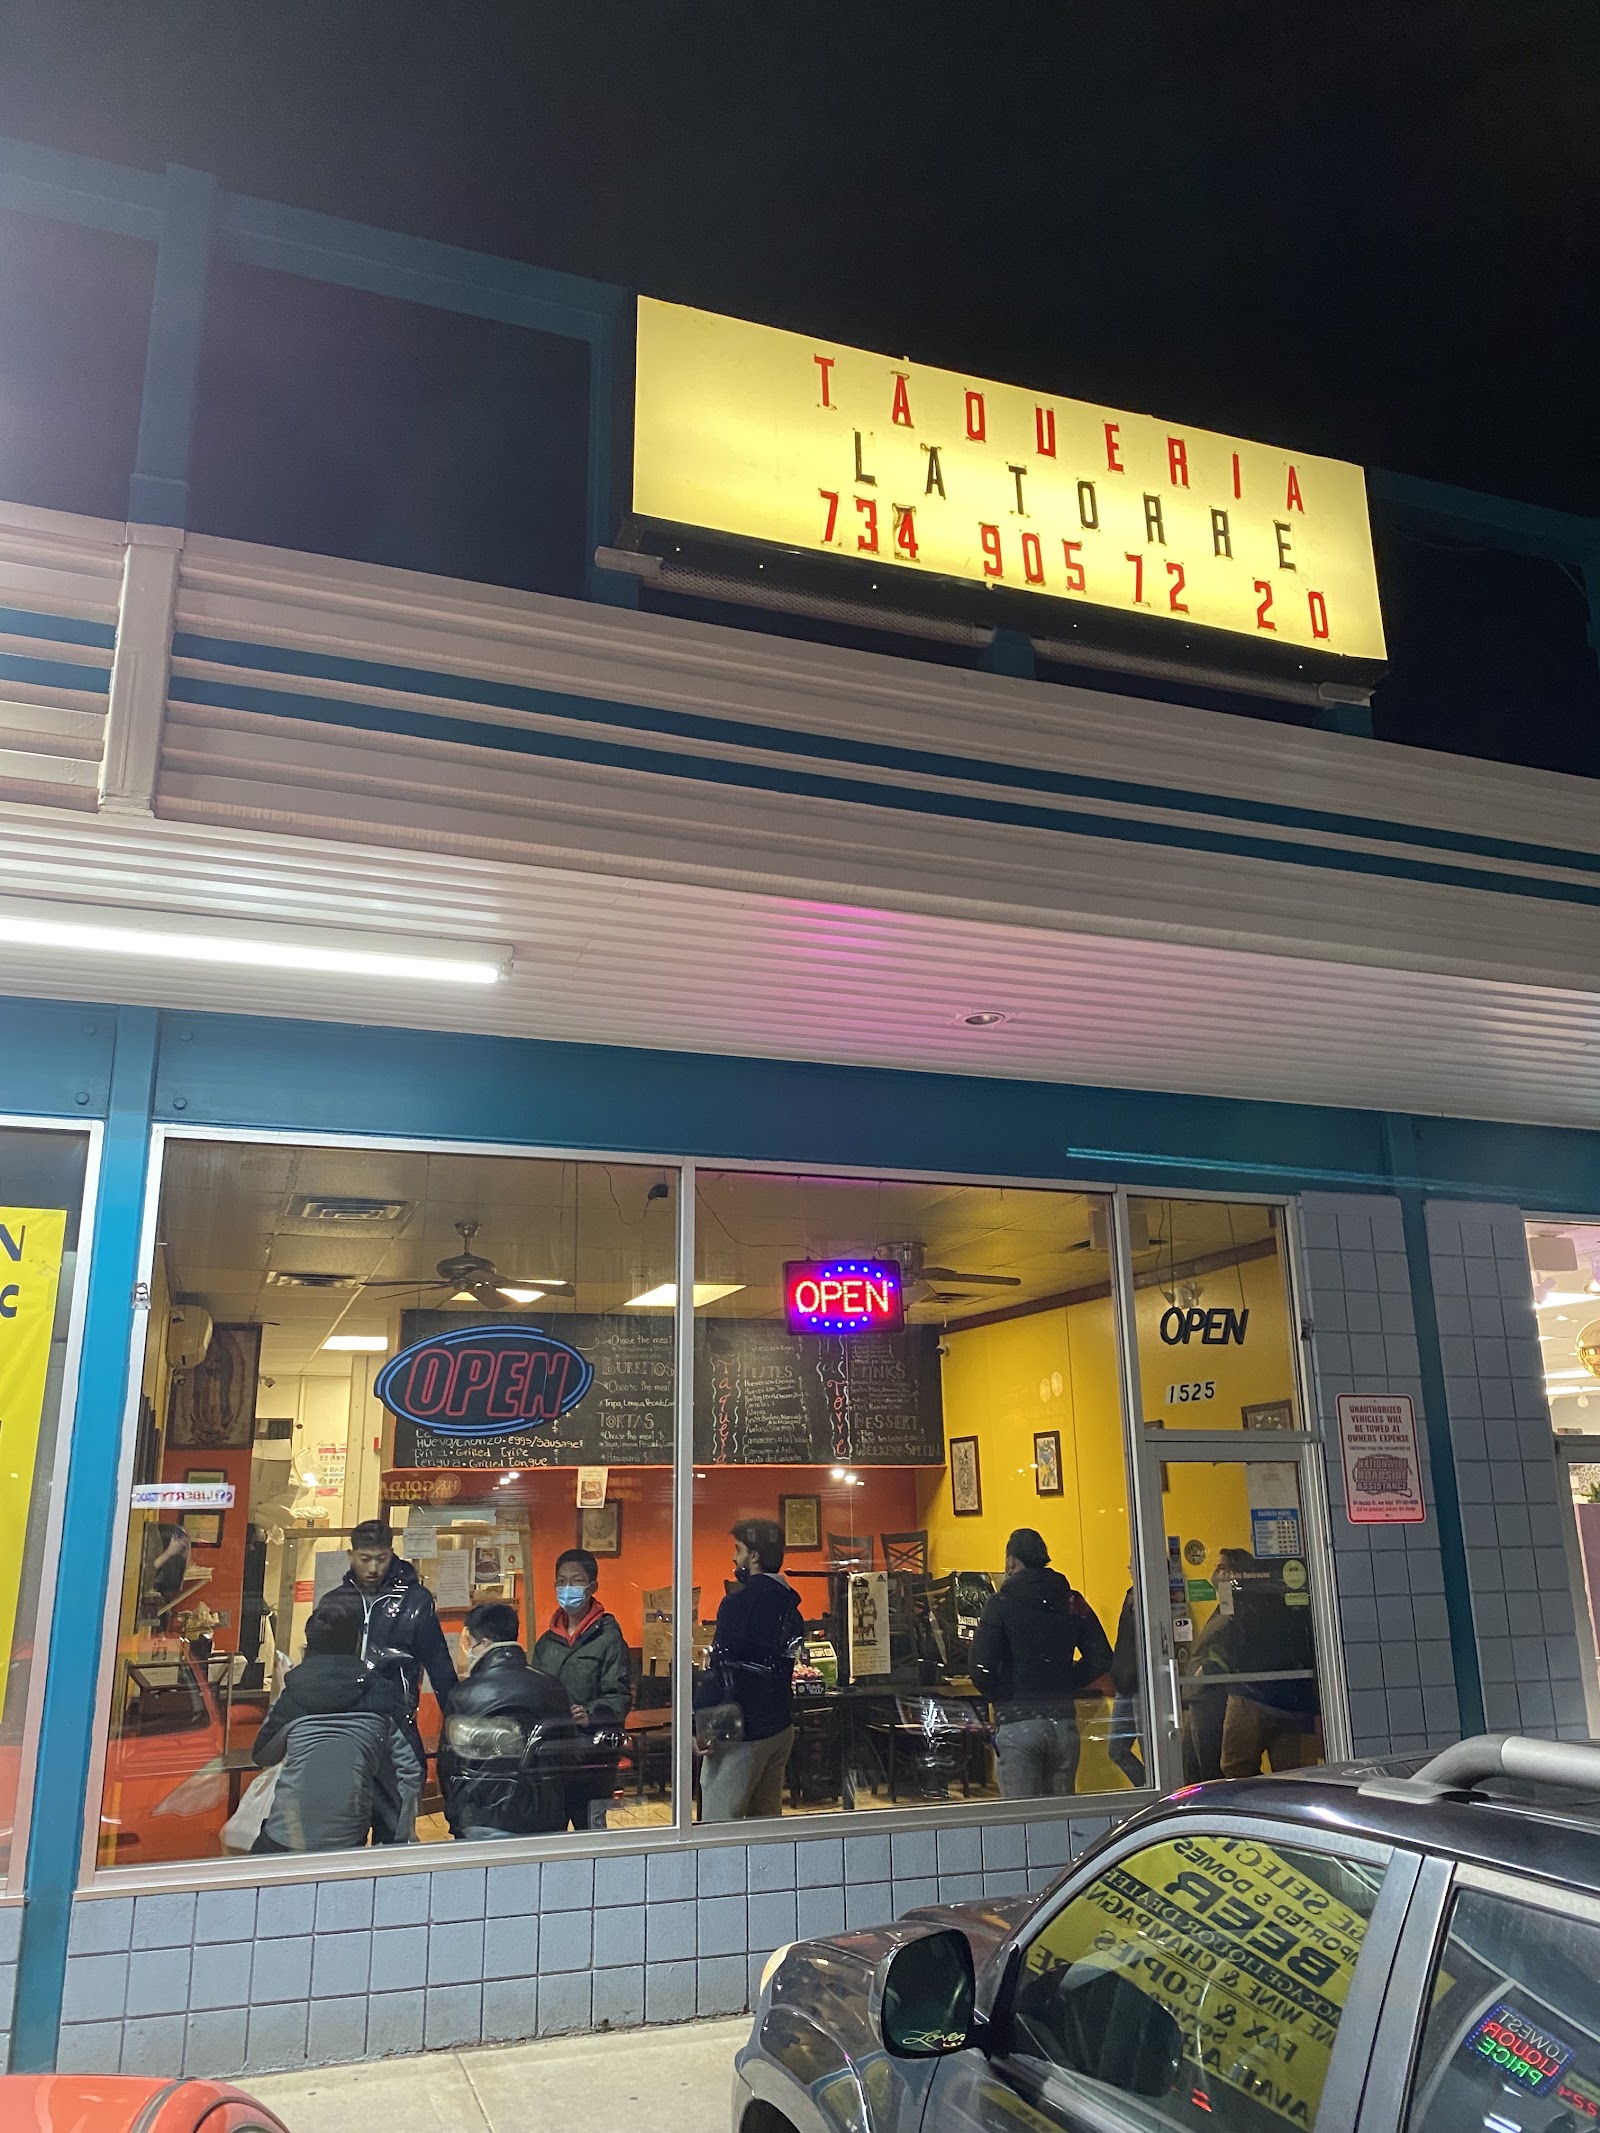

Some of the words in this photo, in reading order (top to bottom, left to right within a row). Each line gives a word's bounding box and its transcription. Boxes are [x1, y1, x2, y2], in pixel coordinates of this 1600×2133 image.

[814, 355, 1305, 512] TAQUERIA
[855, 430, 946, 499] LA
[1008, 465, 1297, 570] TORRE
[819, 490, 920, 560] 734
[980, 523, 1088, 592] 905
[796, 1280, 888, 1312] OPEN
[1160, 1307, 1249, 1345] OPEN
[404, 1348, 570, 1418] OPEN
[1170, 1381, 1215, 1404] 1525
[1350, 1405, 1402, 1413] UNAUTHORIZED
[1351, 1415, 1384, 1423] VEHICLES
[1386, 1415, 1402, 1423] WILL
[596, 1412, 655, 1430] TORTAS
[1354, 1425, 1363, 1433] BE
[1366, 1425, 1389, 1433] TOWED
[1392, 1425, 1400, 1433] AT
[1347, 1434, 1377, 1442] OWNERS
[1379, 1434, 1410, 1442] EXPENSE
[1356, 1482, 1408, 1491] ASSISTANCE
